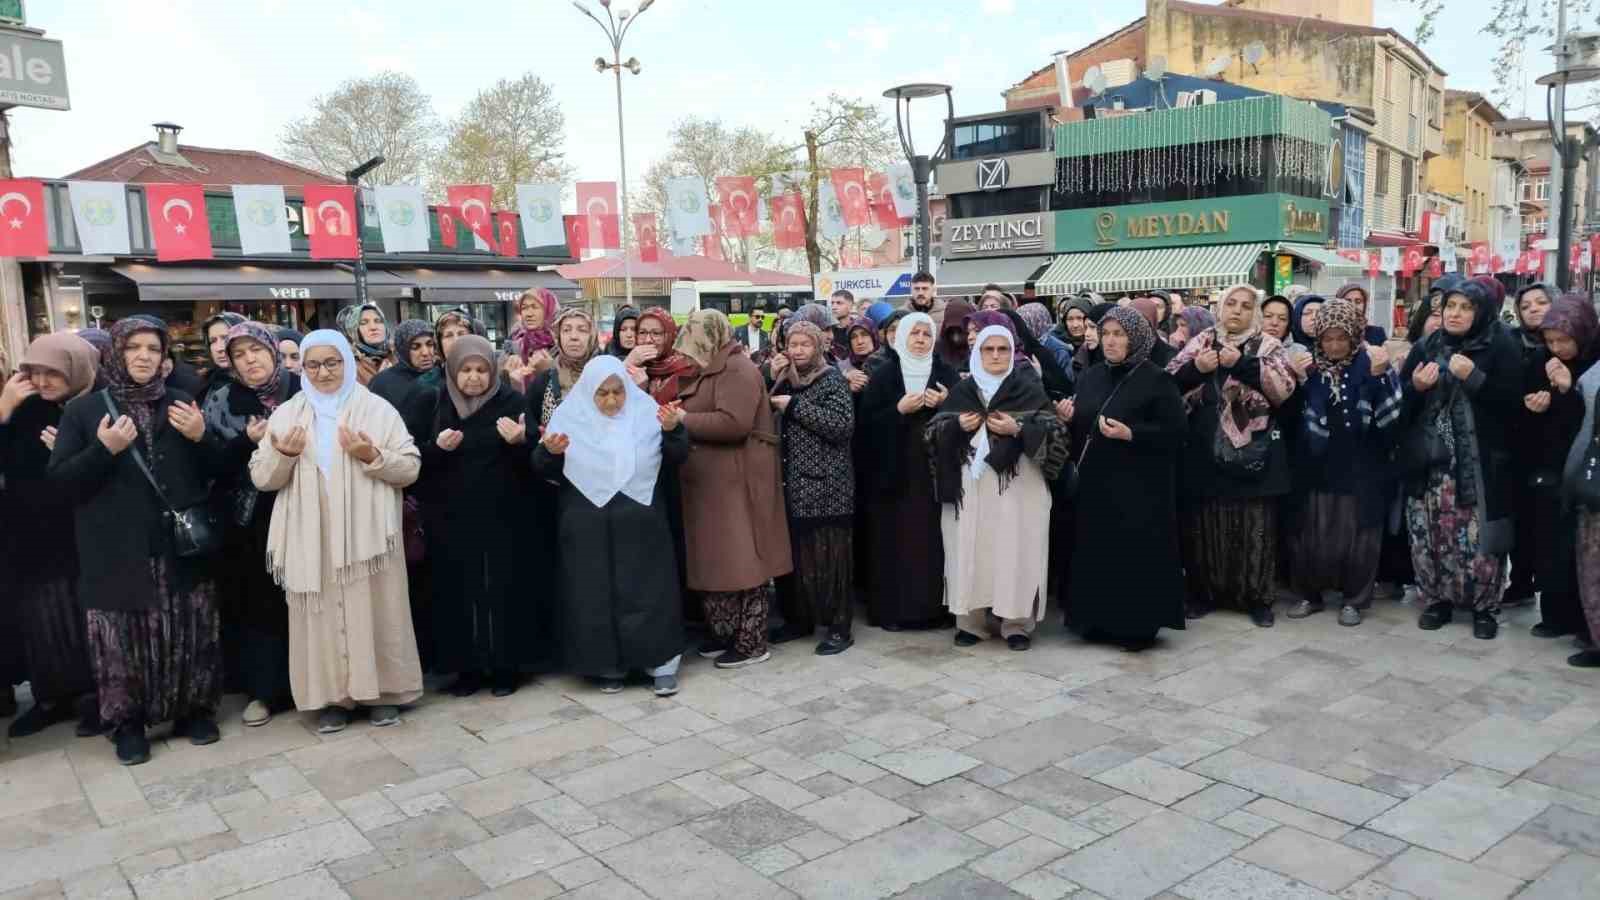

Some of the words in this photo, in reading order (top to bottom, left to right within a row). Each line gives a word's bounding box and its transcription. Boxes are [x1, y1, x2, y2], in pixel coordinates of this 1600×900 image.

[1127, 210, 1229, 238] MEYDAN
[980, 239, 1012, 251] MURAT
[834, 279, 882, 290] TURKCELL
[269, 287, 310, 299] vera
